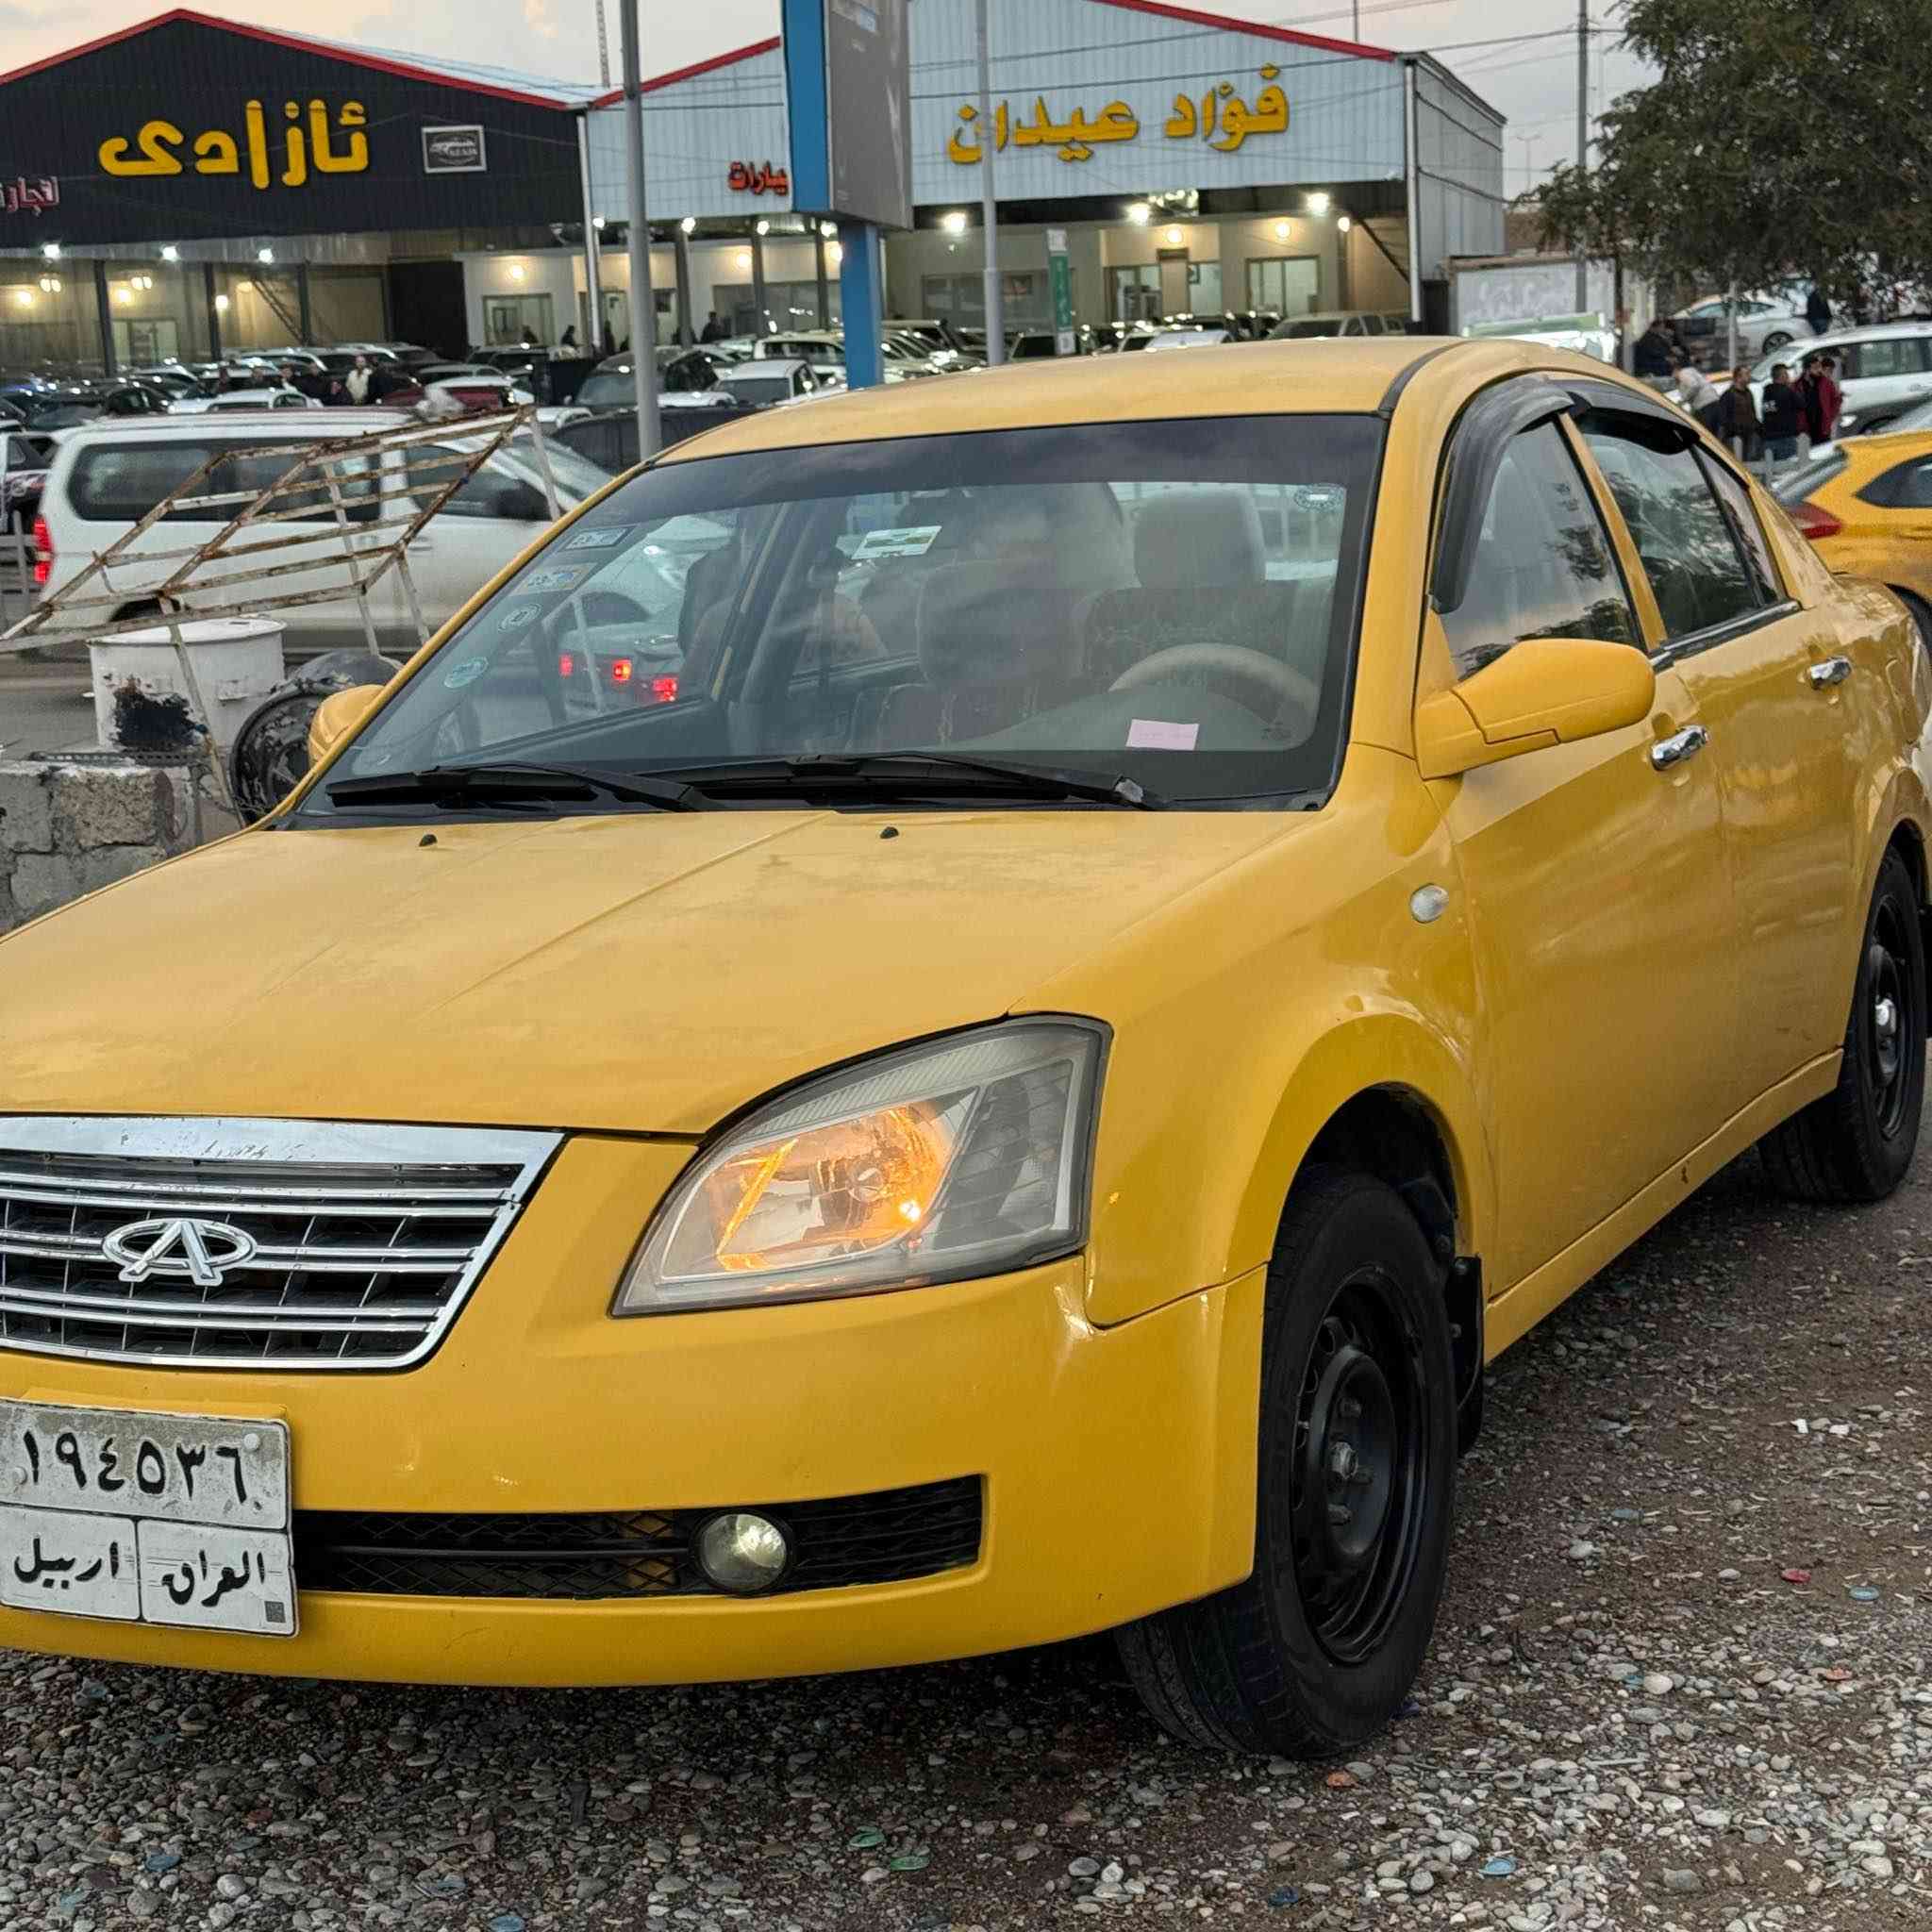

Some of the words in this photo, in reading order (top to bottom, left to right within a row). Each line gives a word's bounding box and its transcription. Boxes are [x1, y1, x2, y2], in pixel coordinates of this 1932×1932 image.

[728, 159, 790, 196] يارات
[23, 1430, 248, 1504] ١٩٤٥٣٦
[161, 1550, 266, 1607] العراق
